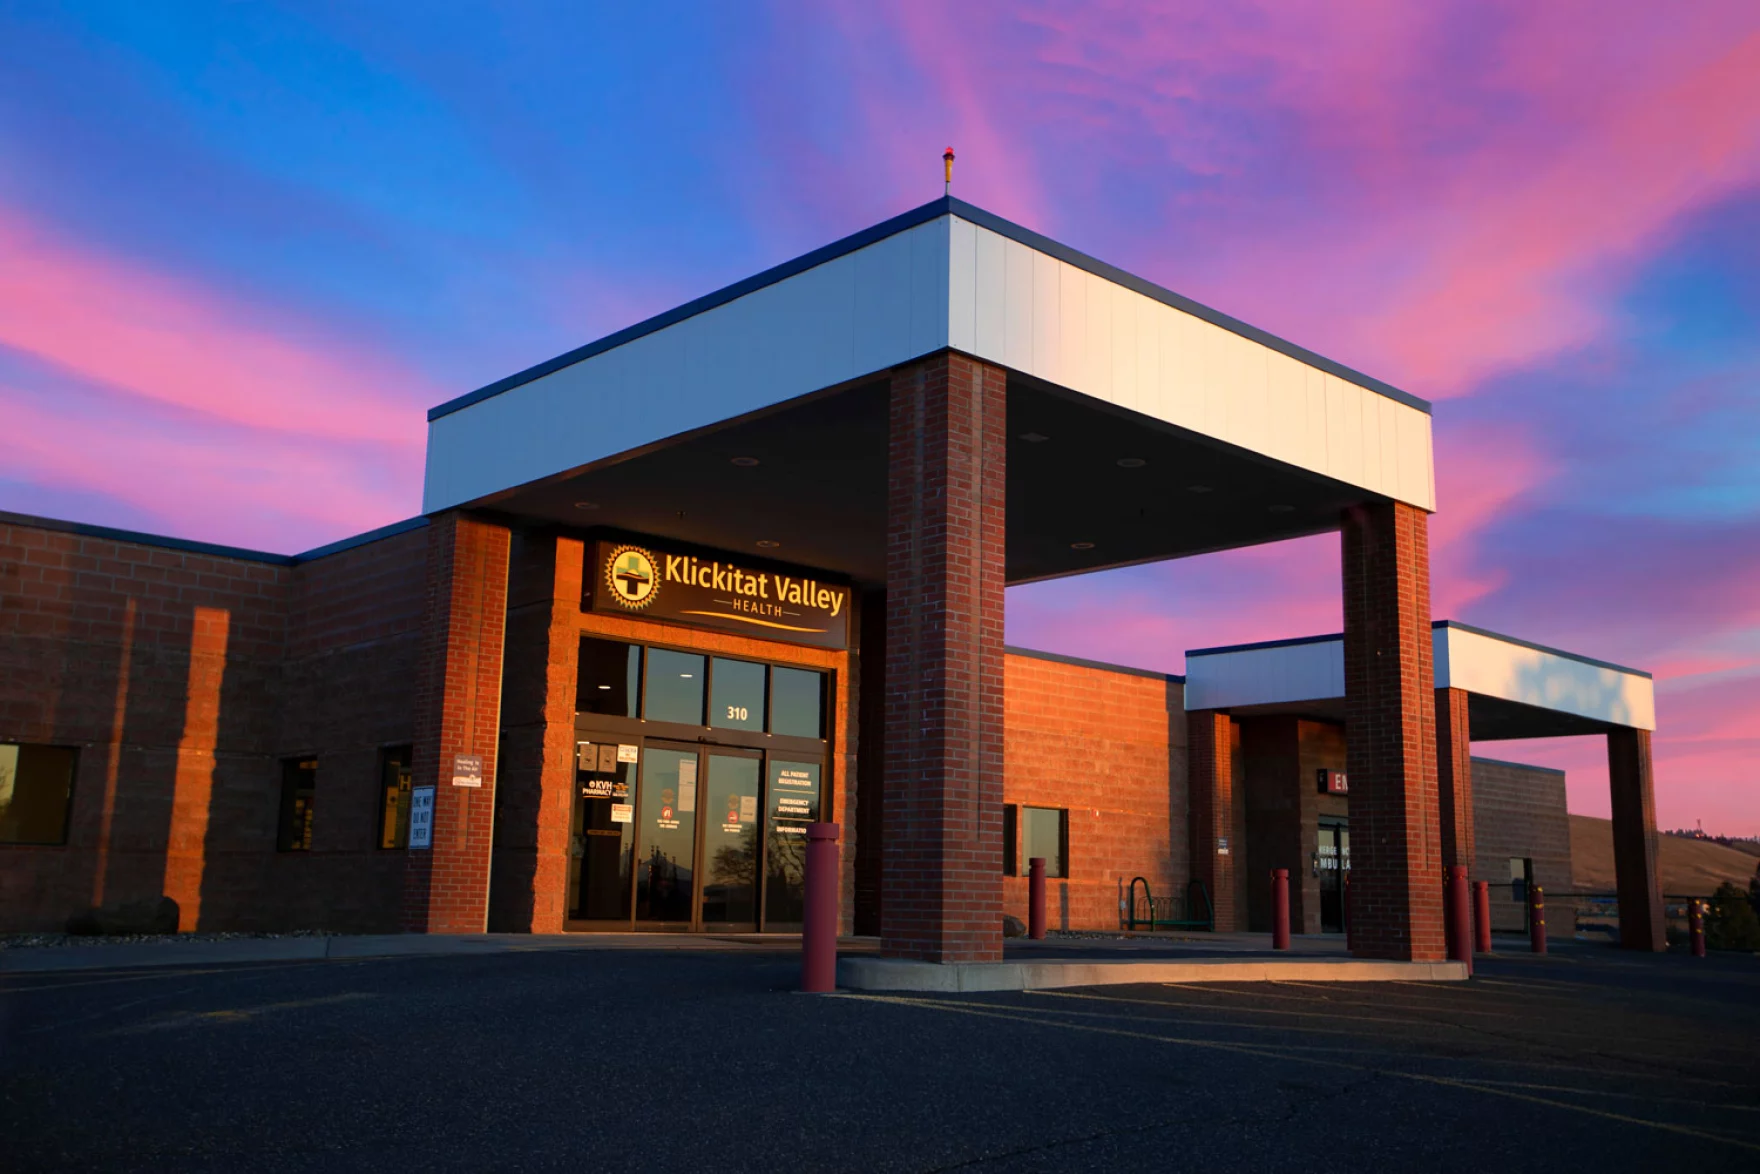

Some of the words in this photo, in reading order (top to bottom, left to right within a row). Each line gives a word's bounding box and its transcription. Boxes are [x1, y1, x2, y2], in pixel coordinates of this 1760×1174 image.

[666, 554, 768, 599] Klickitat
[774, 575, 844, 617] Valley
[733, 598, 783, 617] HEALTH
[727, 705, 748, 721] 310
[781, 769, 790, 777] ALL
[596, 780, 613, 790] KVH
[778, 777, 811, 786] REGISTRATION
[582, 787, 612, 796] PHARMACY
[779, 797, 809, 806] EMERGENCY
[777, 806, 810, 815] DEPARTMENT
